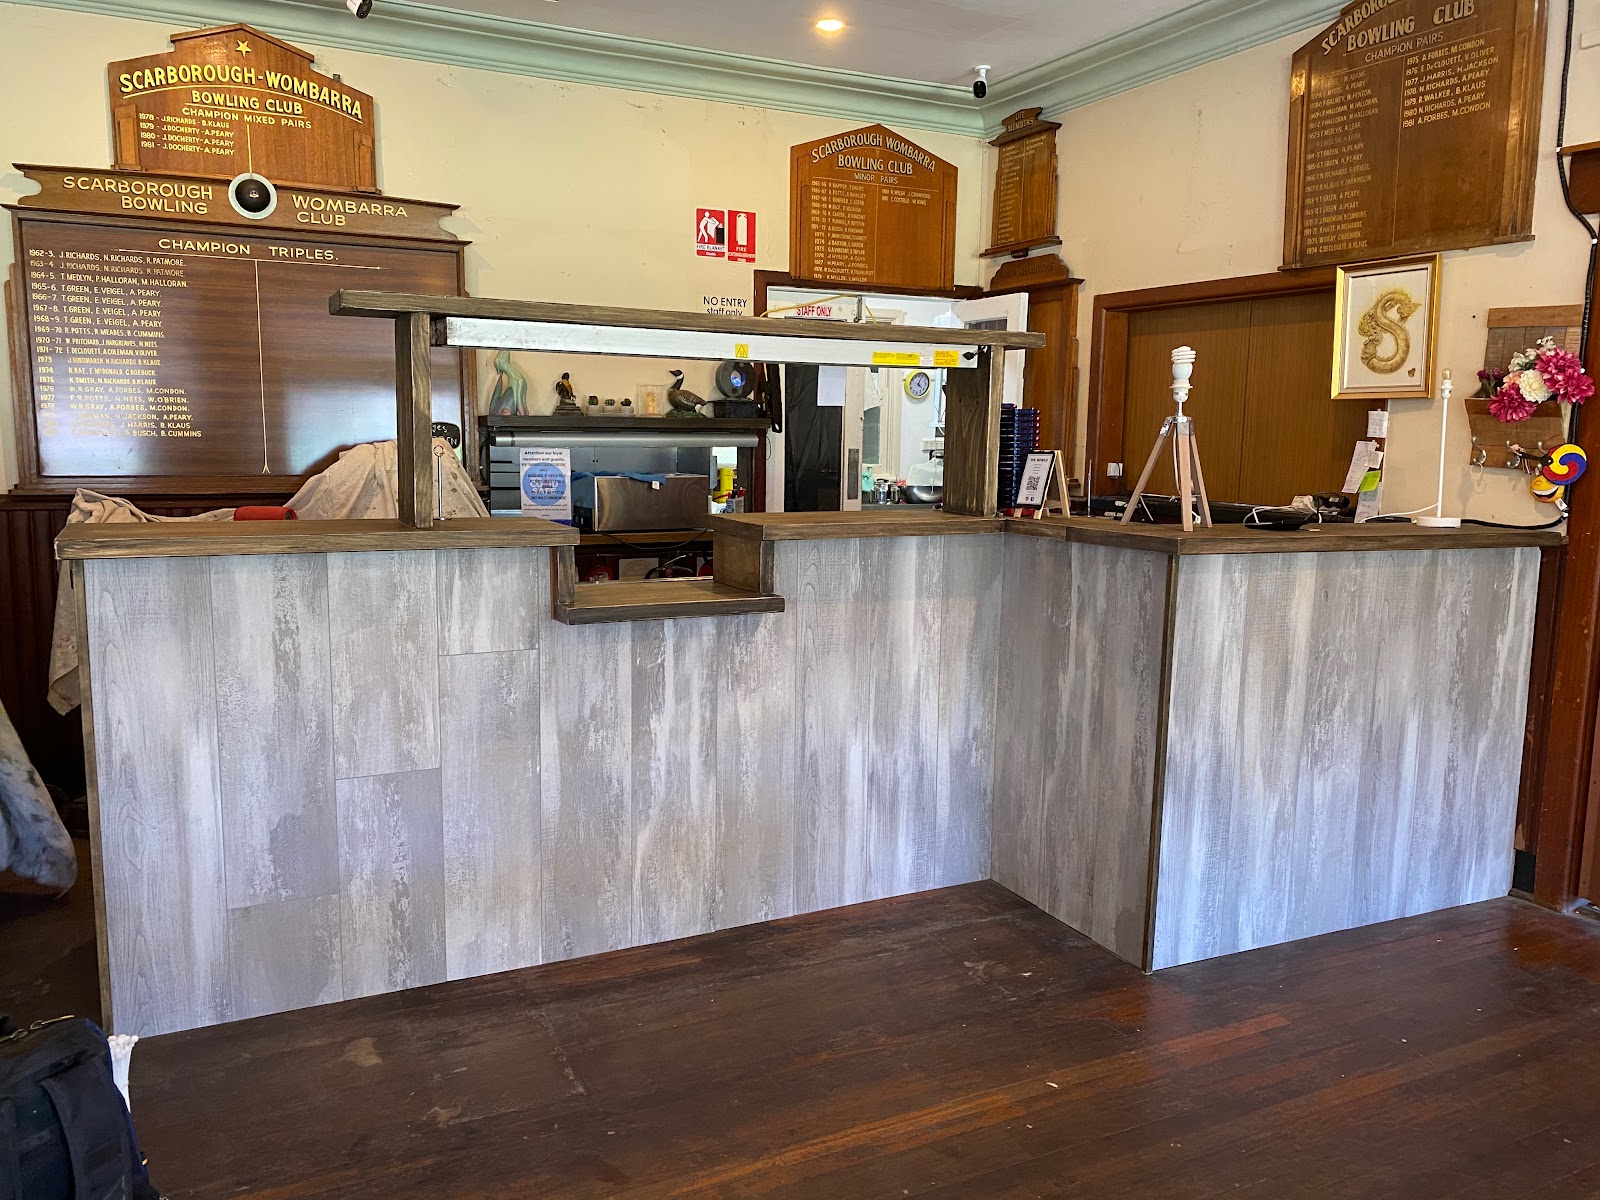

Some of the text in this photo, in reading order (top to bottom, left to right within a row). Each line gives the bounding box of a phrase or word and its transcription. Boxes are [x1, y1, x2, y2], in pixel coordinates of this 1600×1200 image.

[1346, 0, 1475, 52] BOWLING CLUB
[1365, 32, 1444, 63] CHAMPION PAIRS
[191, 90, 303, 115] BOWLING CLUB
[139, 121, 154, 129] 1979
[181, 107, 312, 129] CHAMPION MIXED PAIRS
[811, 132, 936, 172] SCARBOROUGH WOMBARRA
[838, 154, 913, 175] BOWLING CLUB
[854, 173, 899, 184] MINOR PAIRS
[63, 175, 408, 218] SCARBOROUGH WOMBARRA
[120, 195, 347, 227] BOWLING CLUB
[158, 238, 251, 256] CHAMPION
[703, 296, 747, 308] NO ENTRY
[796, 306, 832, 317] STAFF ONLY
